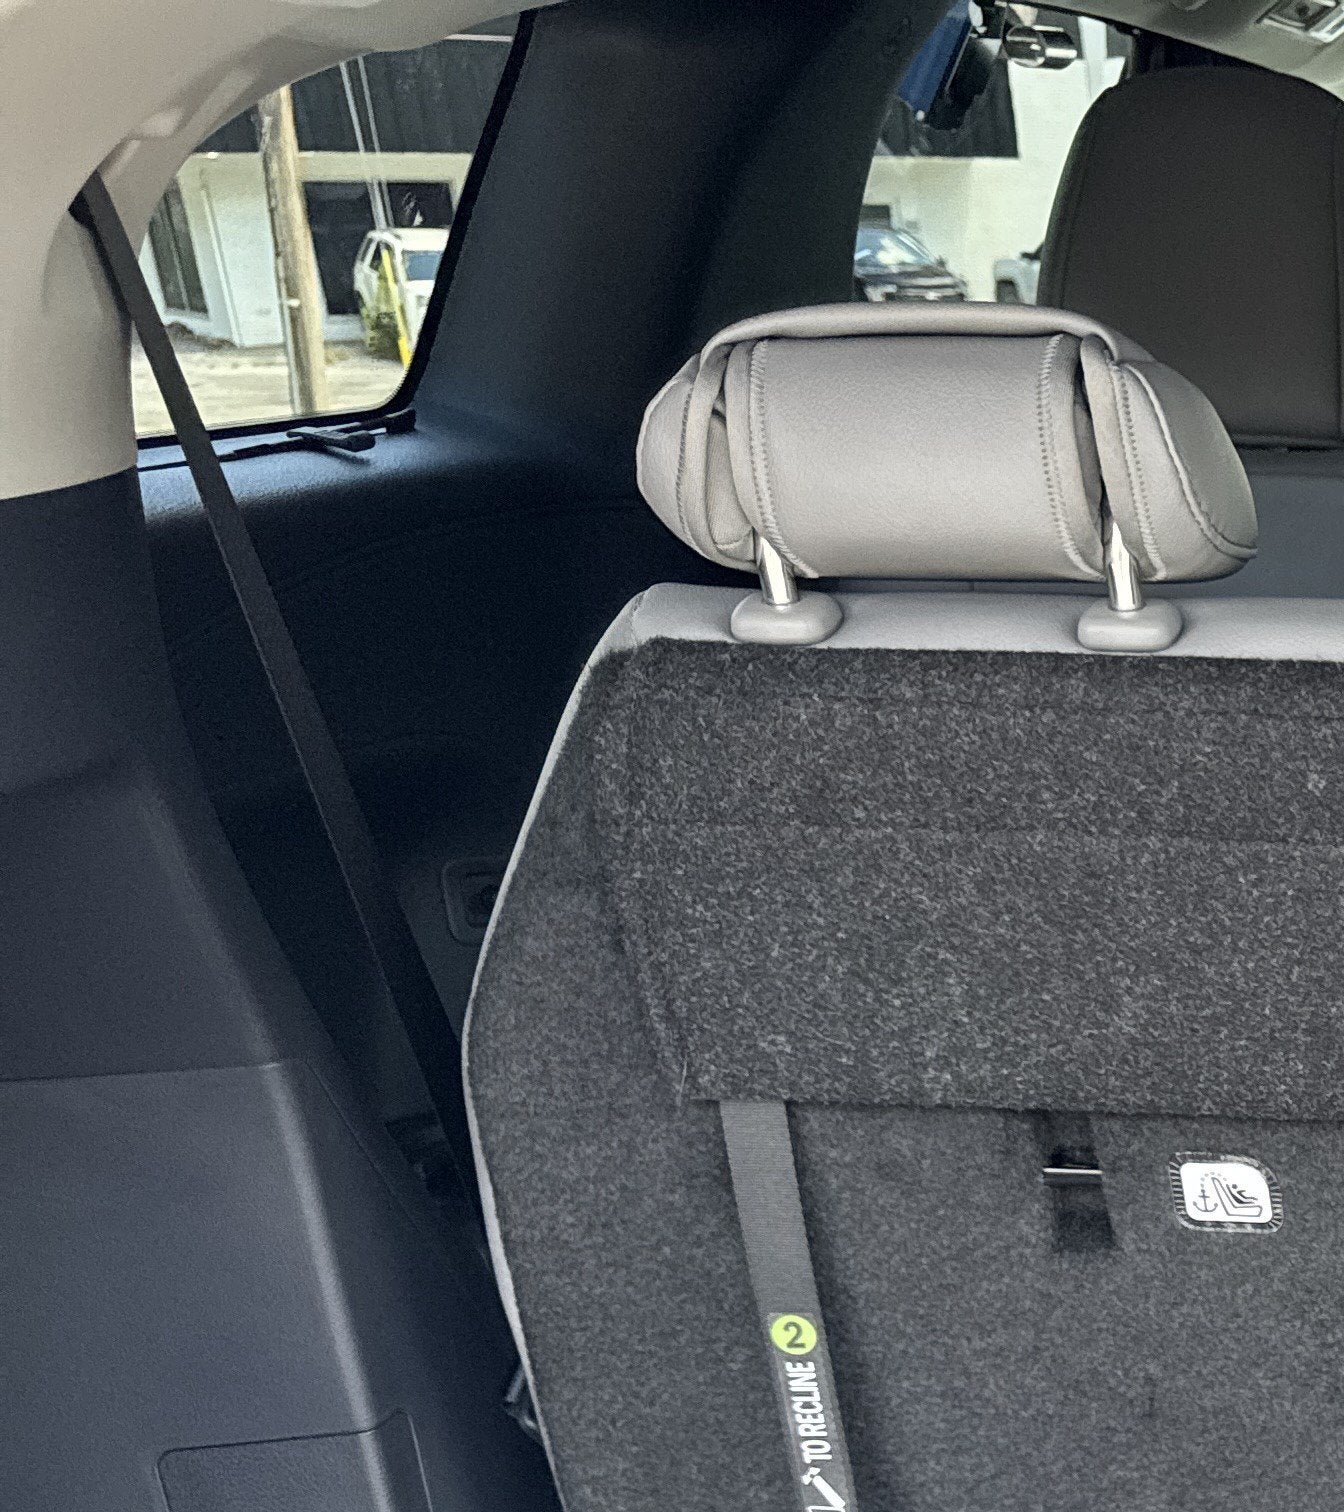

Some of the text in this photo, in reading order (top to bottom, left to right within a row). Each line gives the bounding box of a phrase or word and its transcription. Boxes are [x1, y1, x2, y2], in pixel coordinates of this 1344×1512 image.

[783, 1321, 806, 1349] 2
[785, 1361, 833, 1465] TO RECLINE
